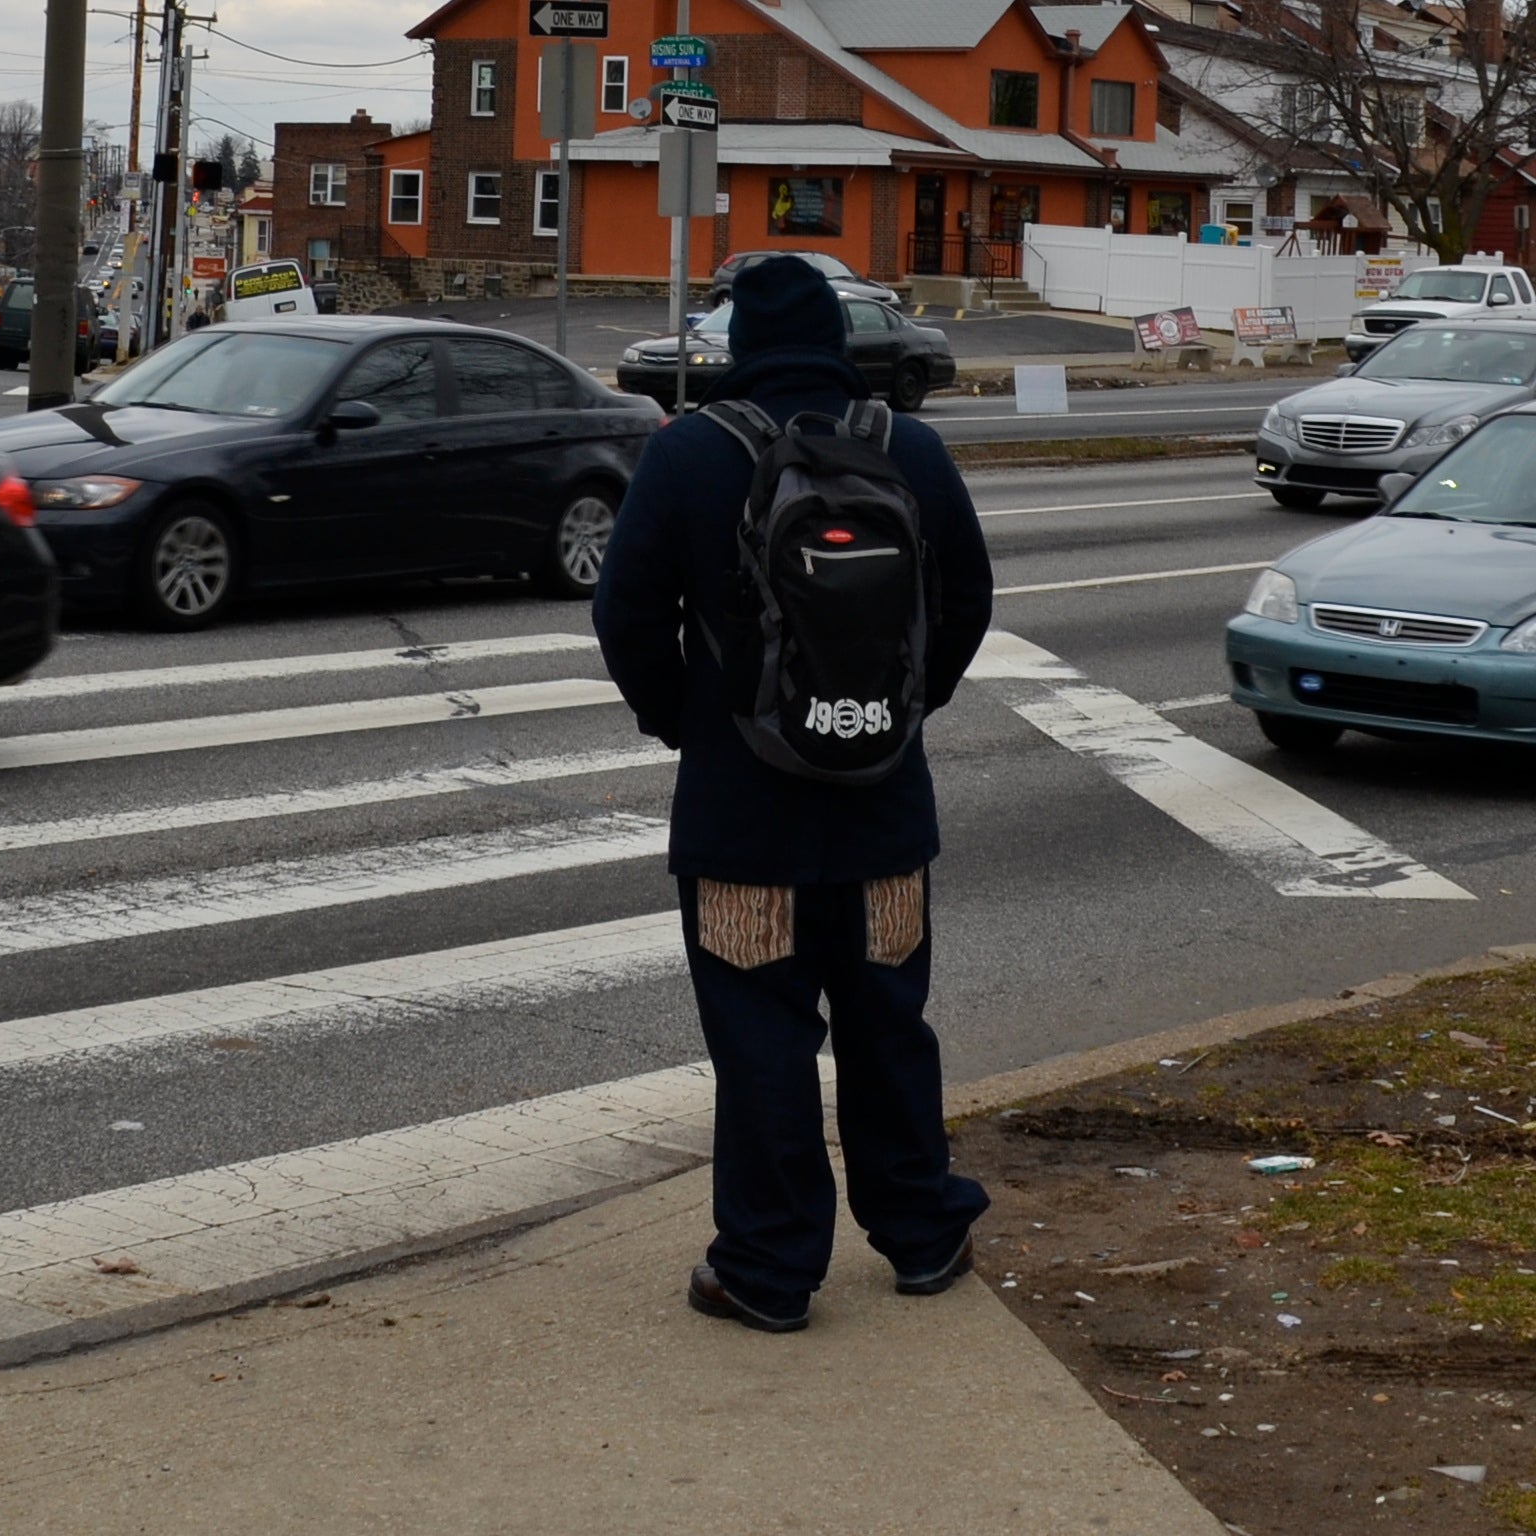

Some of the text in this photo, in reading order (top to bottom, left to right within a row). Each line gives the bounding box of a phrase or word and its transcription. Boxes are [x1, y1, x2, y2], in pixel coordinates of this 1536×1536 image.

[553, 11, 601, 27] ONE WAY
[651, 44, 677, 56] RISING
[678, 44, 695, 56] SUN
[678, 106, 713, 121] ONE WAY
